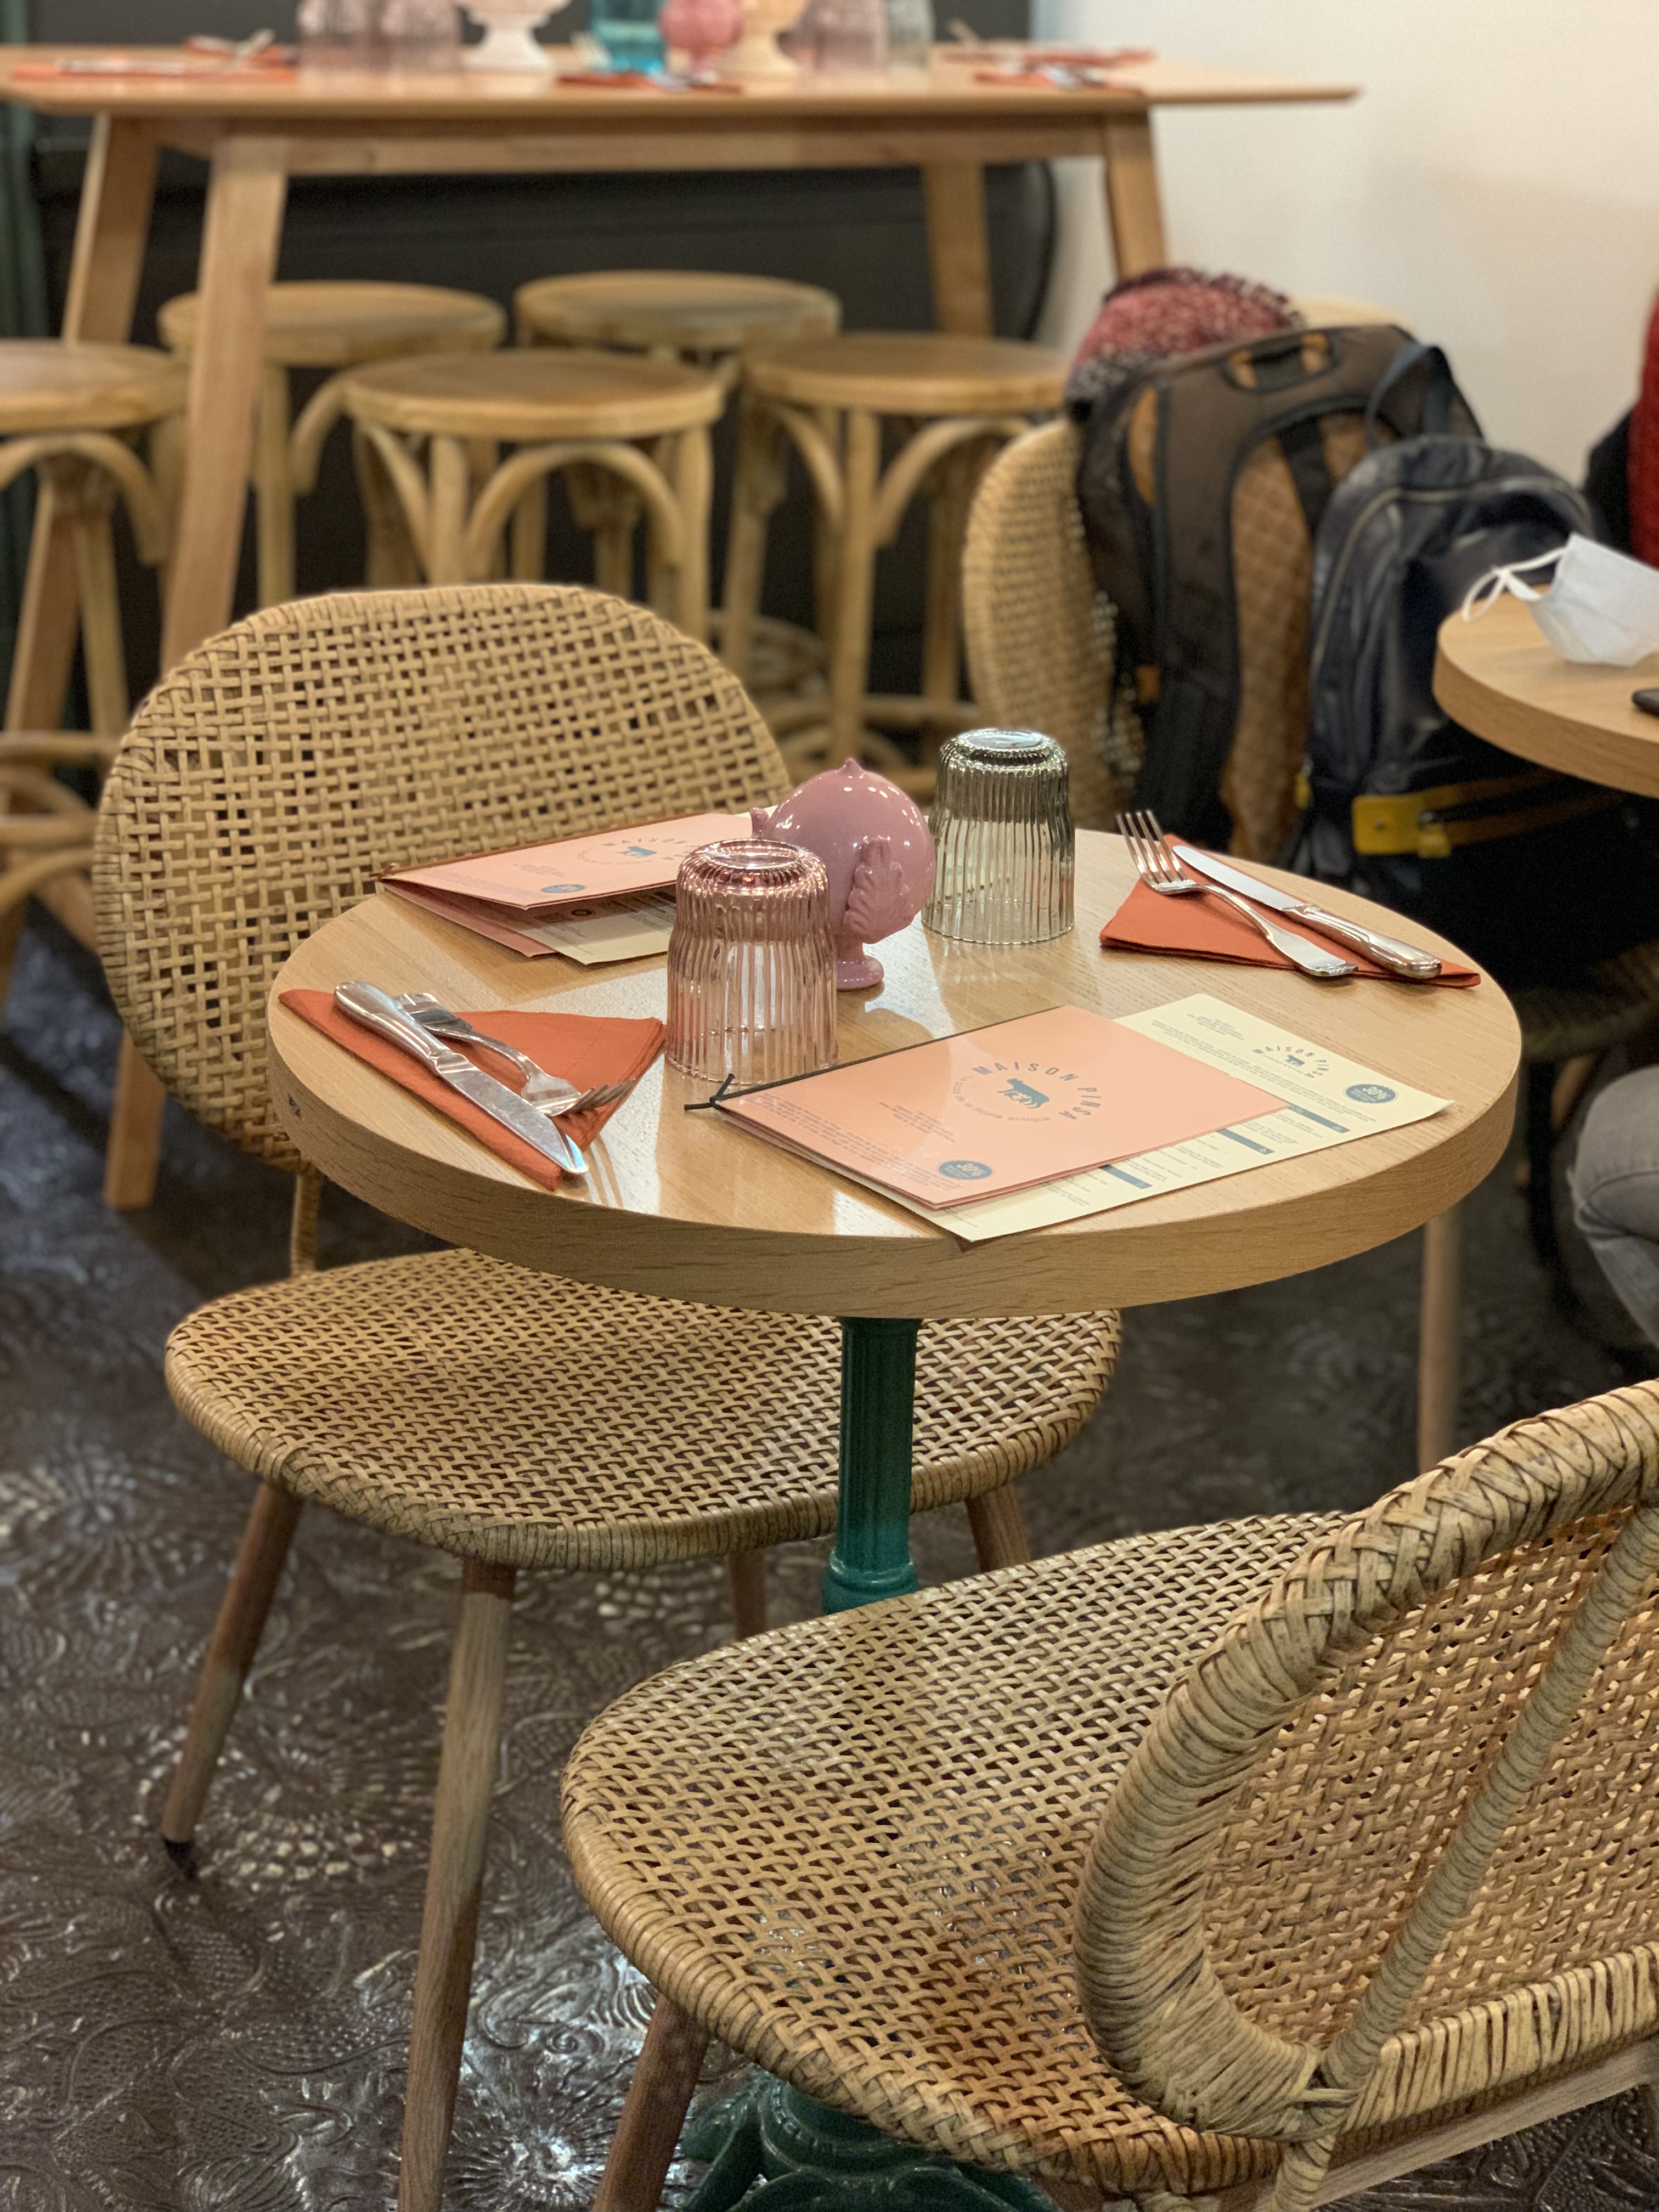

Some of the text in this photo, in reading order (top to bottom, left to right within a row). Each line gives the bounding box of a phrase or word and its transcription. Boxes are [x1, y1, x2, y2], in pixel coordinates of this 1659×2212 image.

[1251, 1046, 1316, 1057] MAISON
[1304, 1059, 1329, 1078] PINSA
[972, 1062, 1102, 1120] MAISON PINSA
[972, 1107, 1003, 1120] Rome
